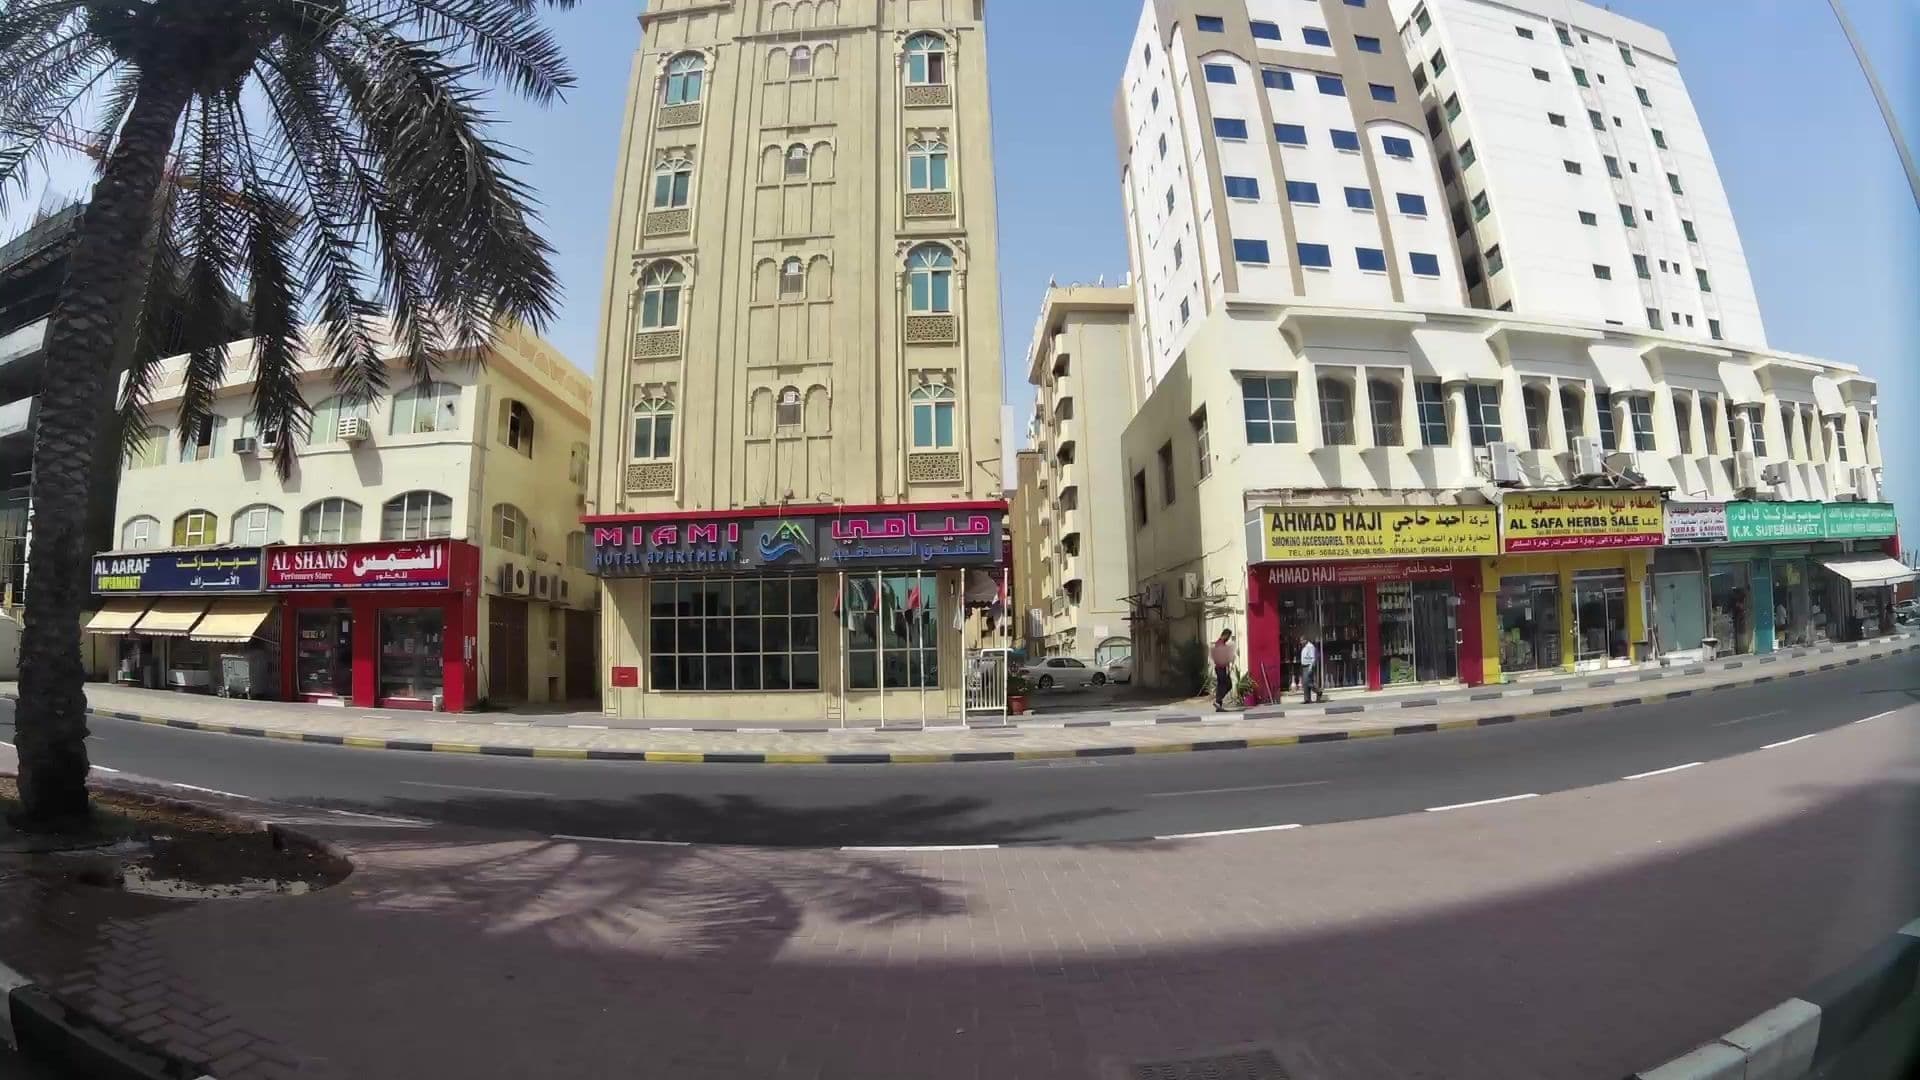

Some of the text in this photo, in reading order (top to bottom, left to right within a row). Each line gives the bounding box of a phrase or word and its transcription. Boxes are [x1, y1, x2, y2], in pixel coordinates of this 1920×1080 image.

[831, 512, 990, 544] ميامي
[1271, 511, 1382, 532] AHMAD HAJI
[1392, 509, 1429, 535] حاجي
[1468, 513, 1489, 527] شركة
[1510, 518, 1527, 530] AL
[1530, 517, 1564, 529] SAFA
[1567, 516, 1607, 528] HERBS
[1610, 515, 1639, 527] SALE
[594, 522, 739, 547] MIAMI
[1755, 523, 1819, 536] SUPERMARKET
[1271, 535, 1300, 546] SMOKING
[94, 557, 151, 575] AL AARAF
[175, 554, 258, 571] سوبرماركت
[271, 550, 348, 571] AL SHAMS
[352, 543, 442, 577] الشمس
[593, 550, 640, 567] HOTEL
[647, 548, 739, 566] APARTMENT
[98, 576, 141, 590] SUPERMARKET
[189, 571, 240, 588] الأعراف
[314, 571, 333, 580] Store
[1268, 567, 1309, 584] AHMAD
[1312, 566, 1336, 582] HAJI
